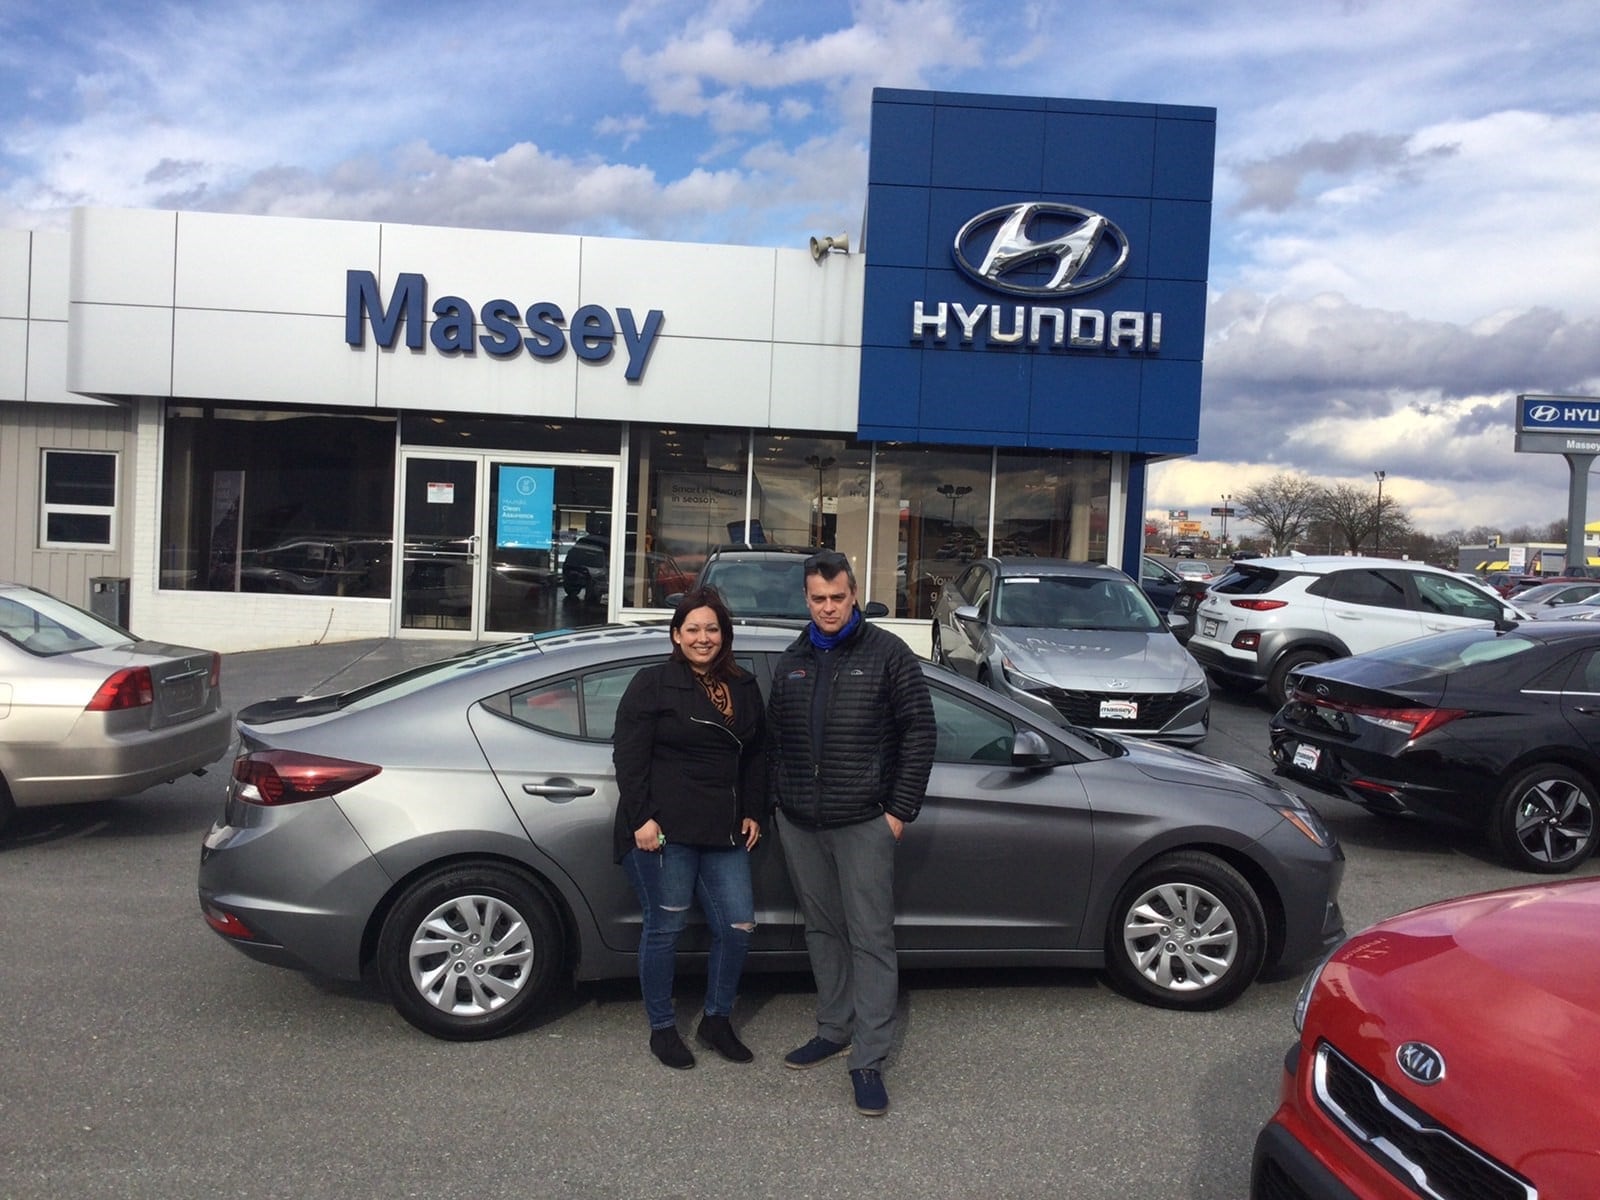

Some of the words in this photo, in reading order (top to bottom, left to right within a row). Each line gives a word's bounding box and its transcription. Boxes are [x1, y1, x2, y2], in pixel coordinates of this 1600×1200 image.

[345, 269, 664, 384] Massey
[911, 300, 1162, 352] HYUNDAI
[1403, 1044, 1435, 1079] KIA
